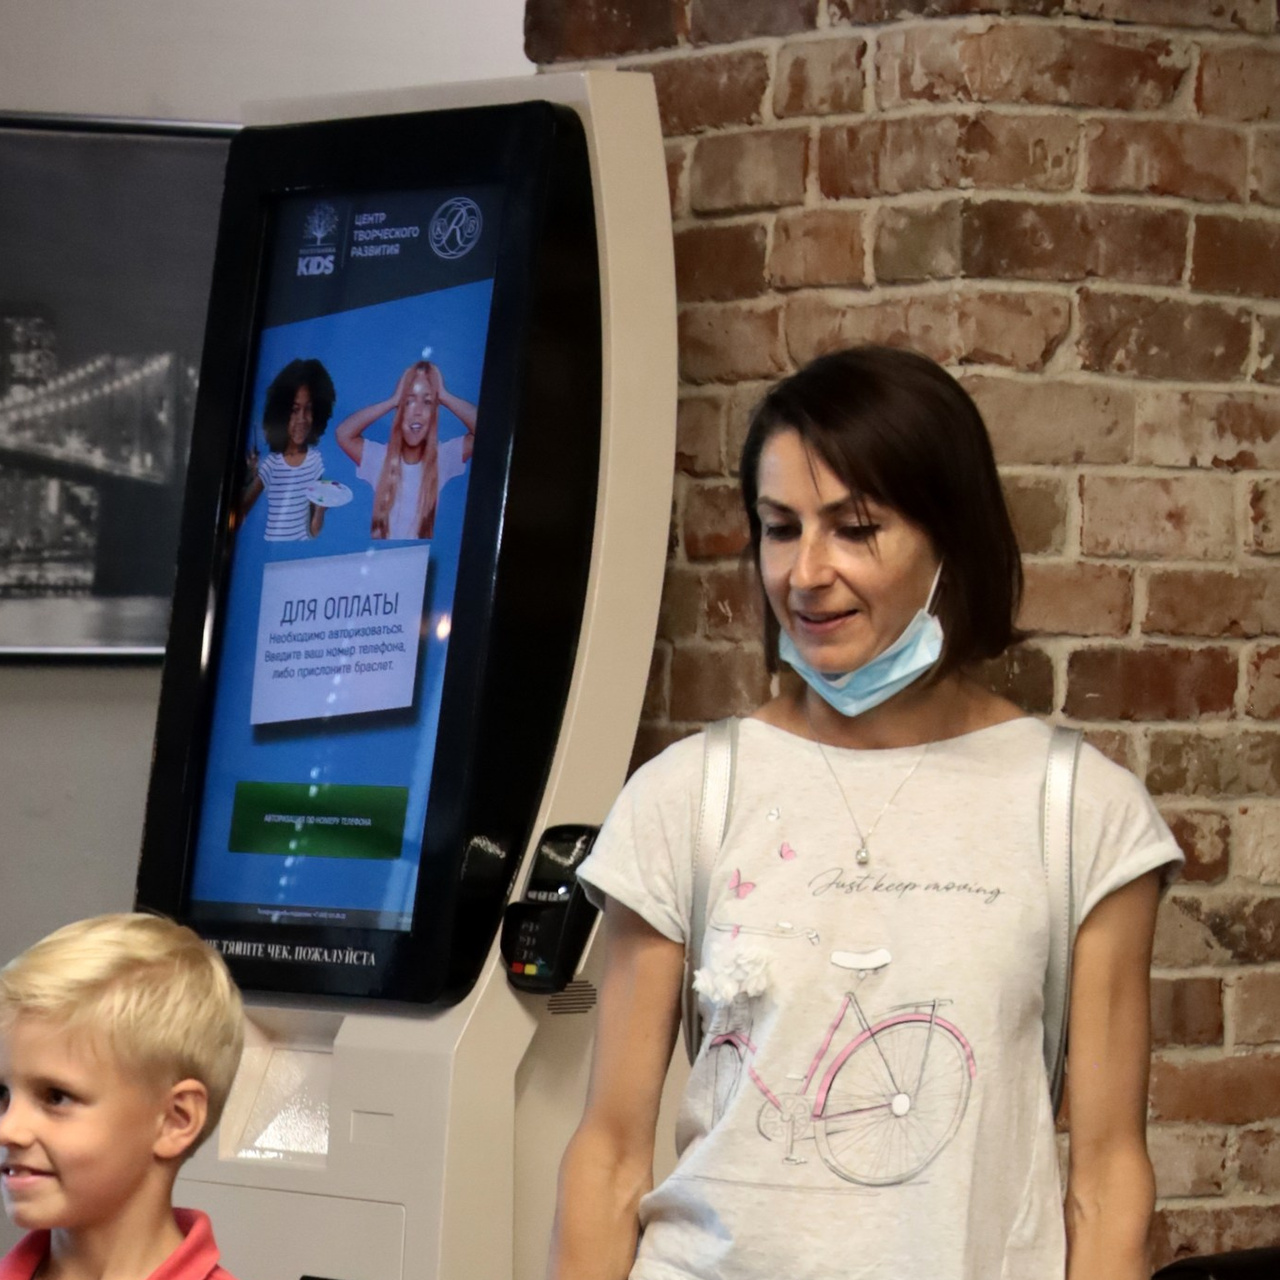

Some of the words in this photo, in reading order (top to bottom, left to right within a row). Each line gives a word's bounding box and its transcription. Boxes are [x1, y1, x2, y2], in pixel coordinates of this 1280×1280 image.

[355, 212, 387, 225] ЦЕНТР
[353, 226, 420, 241] ТВОРЧЕСКОГО
[350, 244, 400, 257] РАЗВИТИЯ
[296, 255, 335, 276] KIDS
[280, 598, 317, 627] ДЛЯ
[324, 592, 399, 620] ОПЛАТЫ
[269, 631, 325, 644] Необходимо
[264, 649, 301, 662] Введите
[304, 648, 324, 659] ваш
[326, 645, 355, 658] номер
[272, 666, 296, 679] либо
[297, 664, 351, 679] прислоните
[808, 867, 876, 897] Just
[872, 873, 921, 899] keep
[924, 881, 1006, 905] moving
[294, 945, 376, 967] ПОЖАЛУЙСТА
